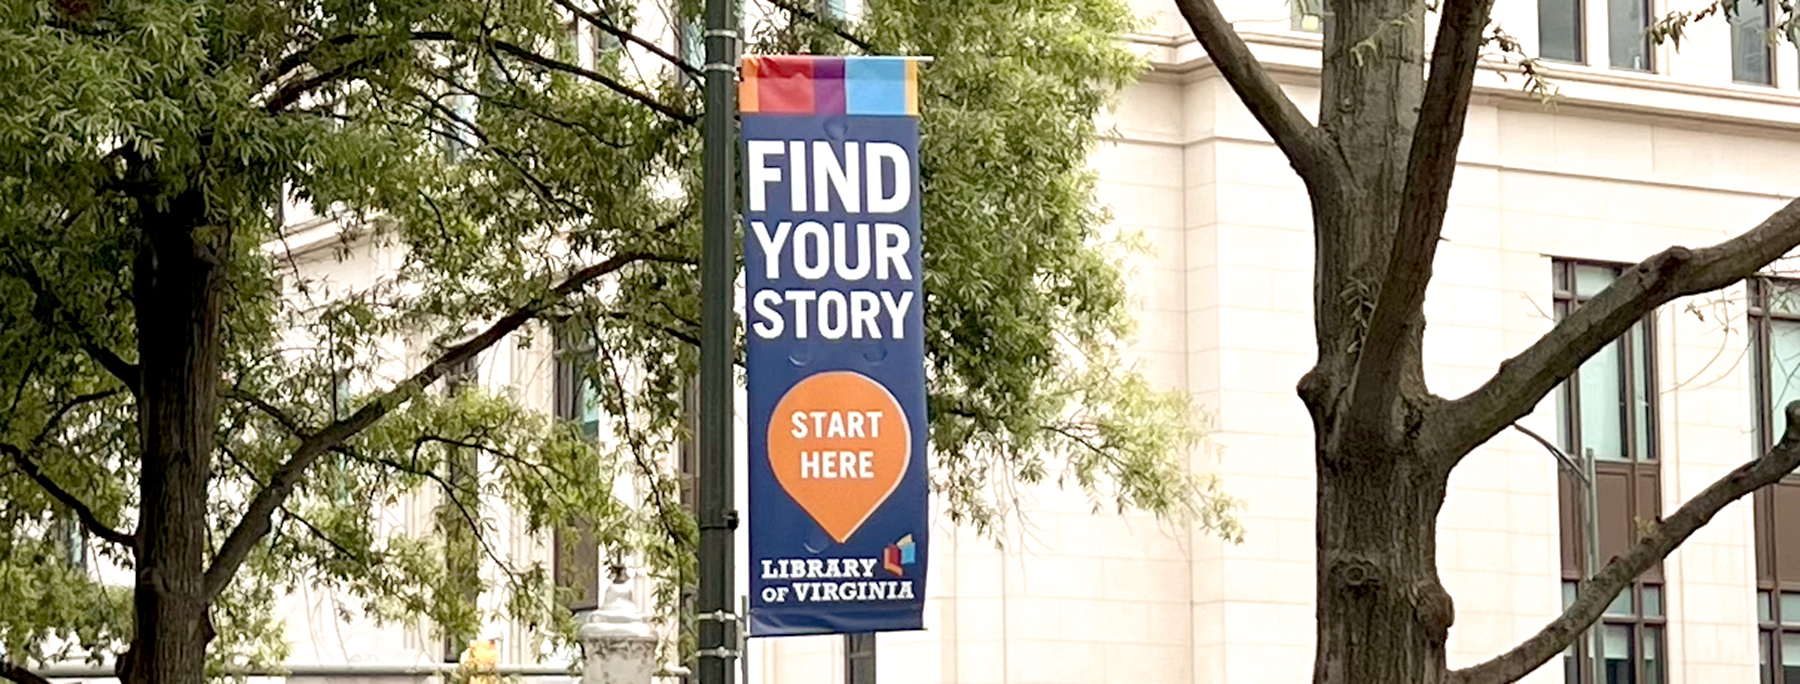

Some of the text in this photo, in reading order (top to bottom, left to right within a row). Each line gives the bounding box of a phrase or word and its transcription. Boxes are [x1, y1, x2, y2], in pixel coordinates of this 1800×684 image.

[747, 139, 911, 214] FIND
[750, 220, 913, 281] YOUR
[752, 289, 914, 340] STORY
[790, 410, 883, 439] START
[800, 450, 875, 479] HERE
[761, 558, 878, 579] LIBRARY
[792, 580, 915, 602] VIRGINIA
